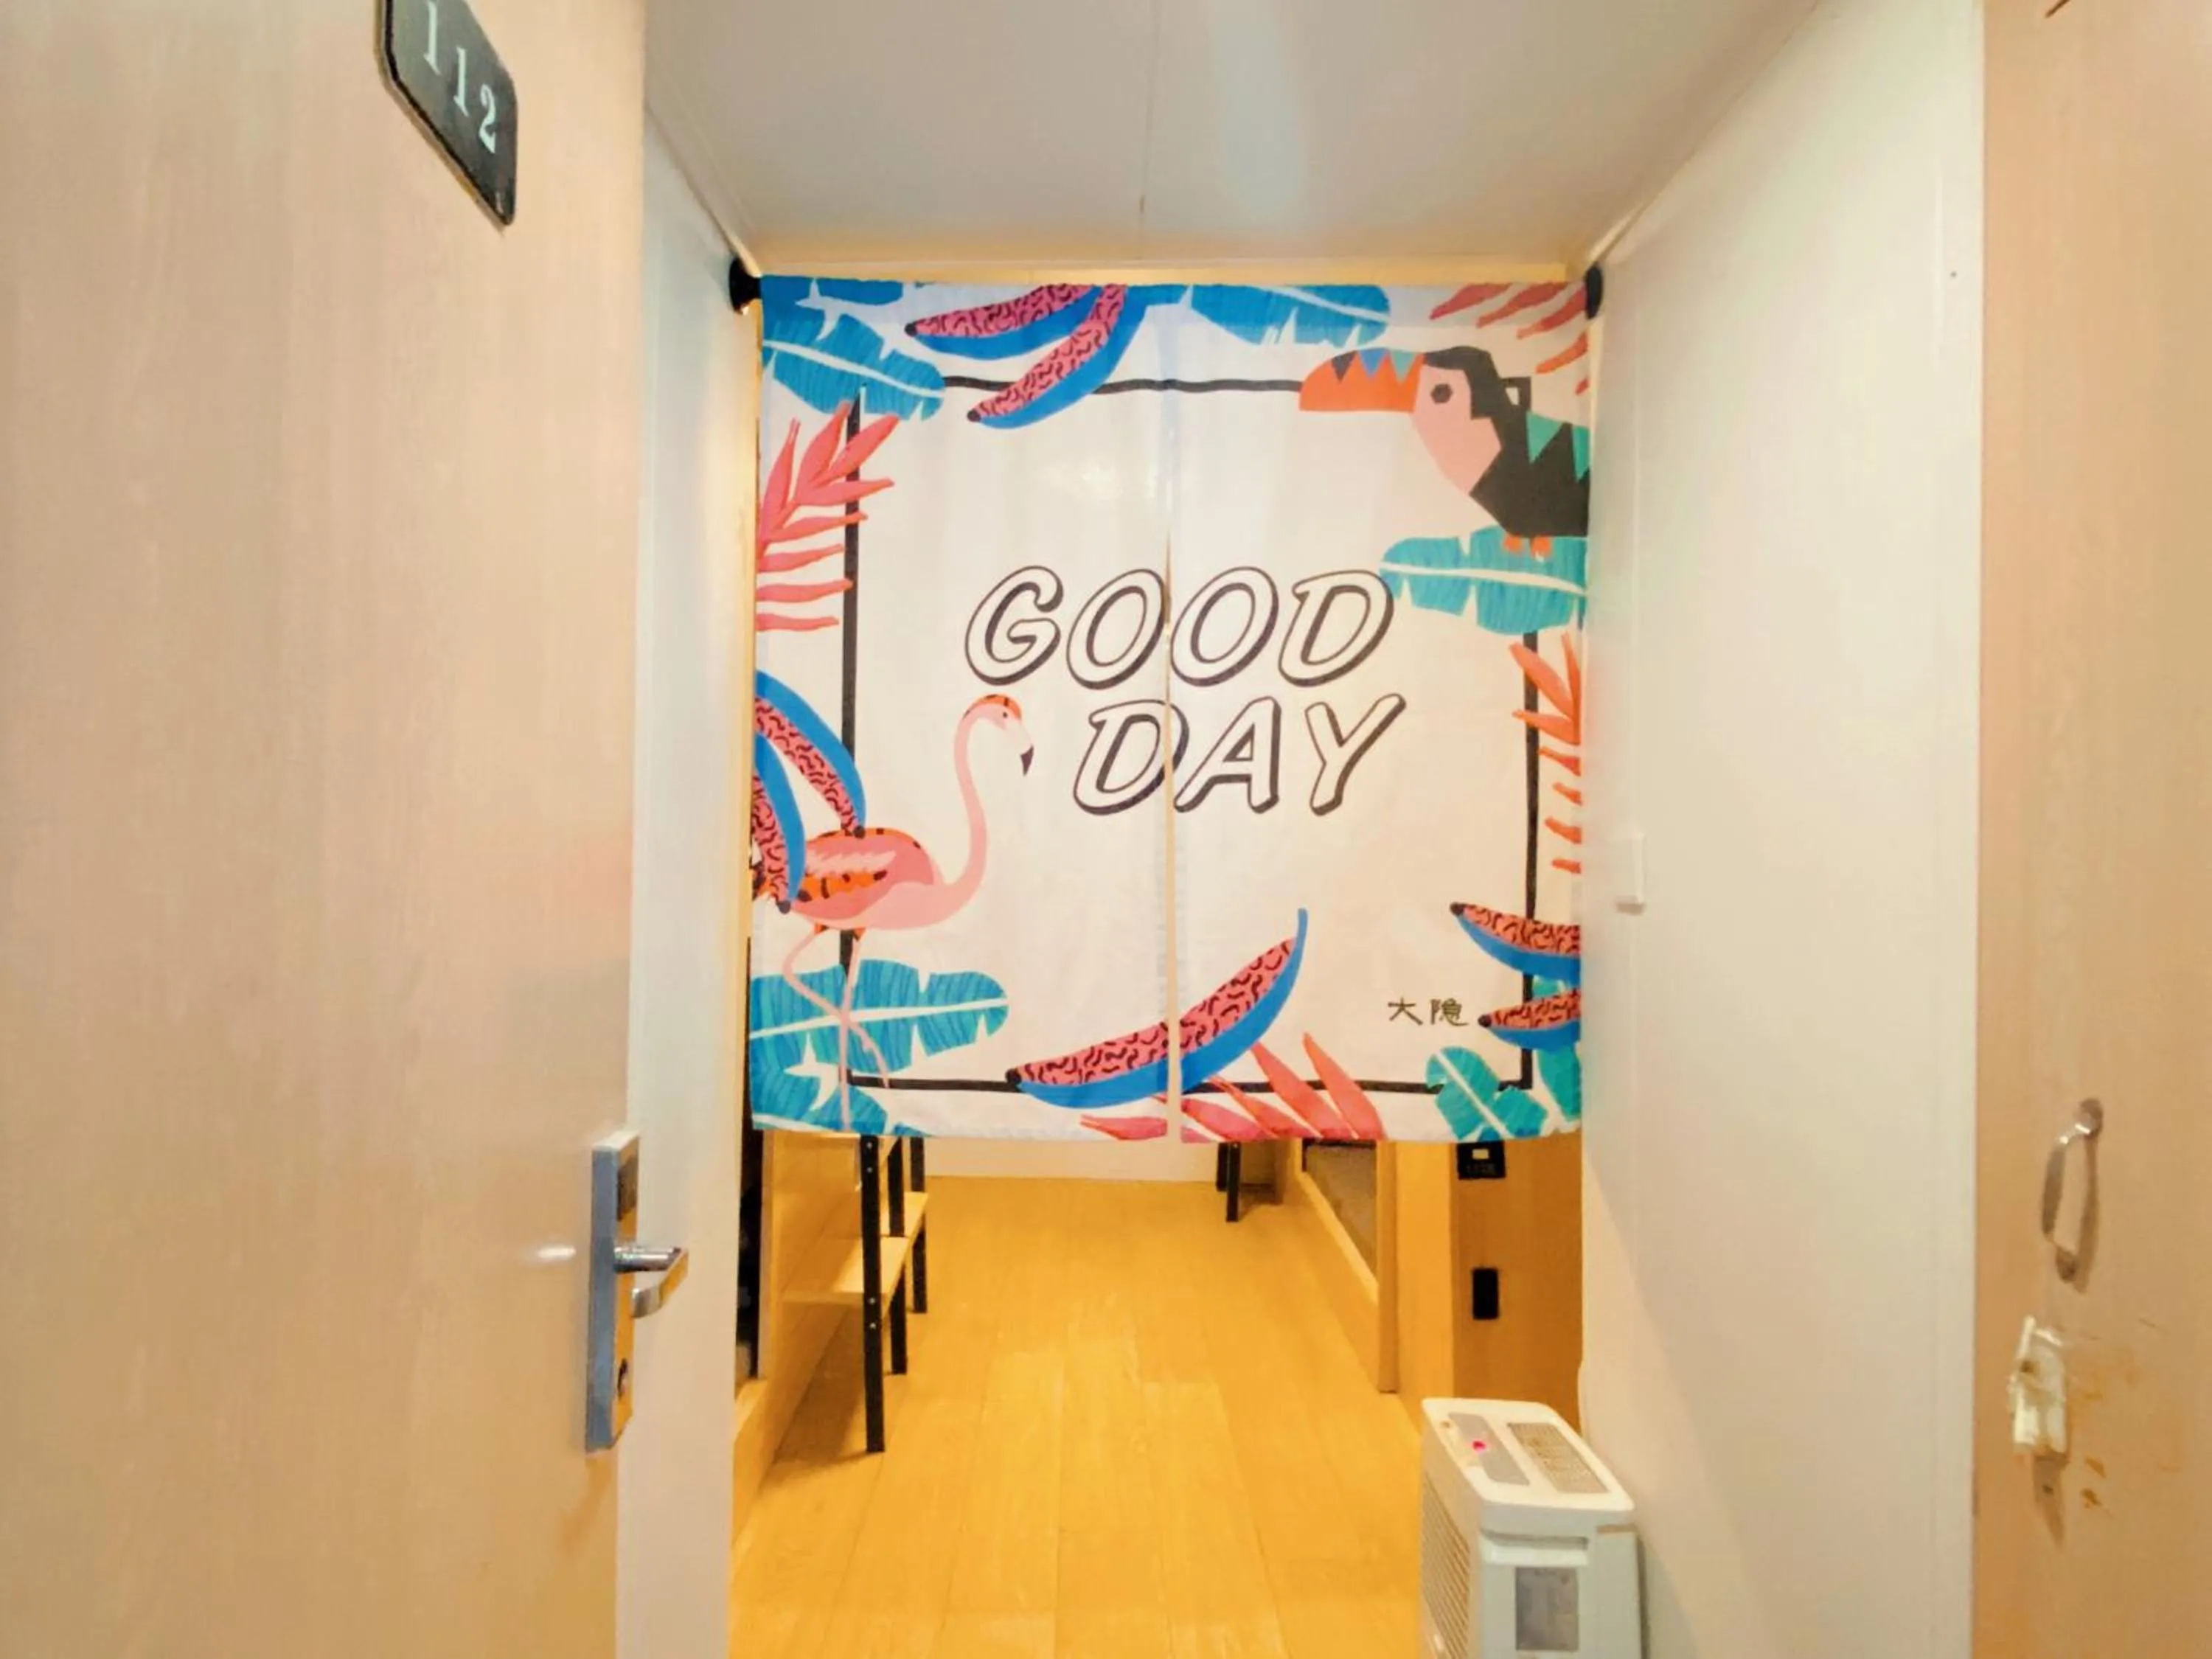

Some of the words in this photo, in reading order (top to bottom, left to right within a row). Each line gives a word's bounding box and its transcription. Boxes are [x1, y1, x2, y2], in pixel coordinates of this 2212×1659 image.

[422, 0, 496, 153] 112
[964, 565, 1394, 689] GOOD
[1073, 693, 1407, 815] DAY
